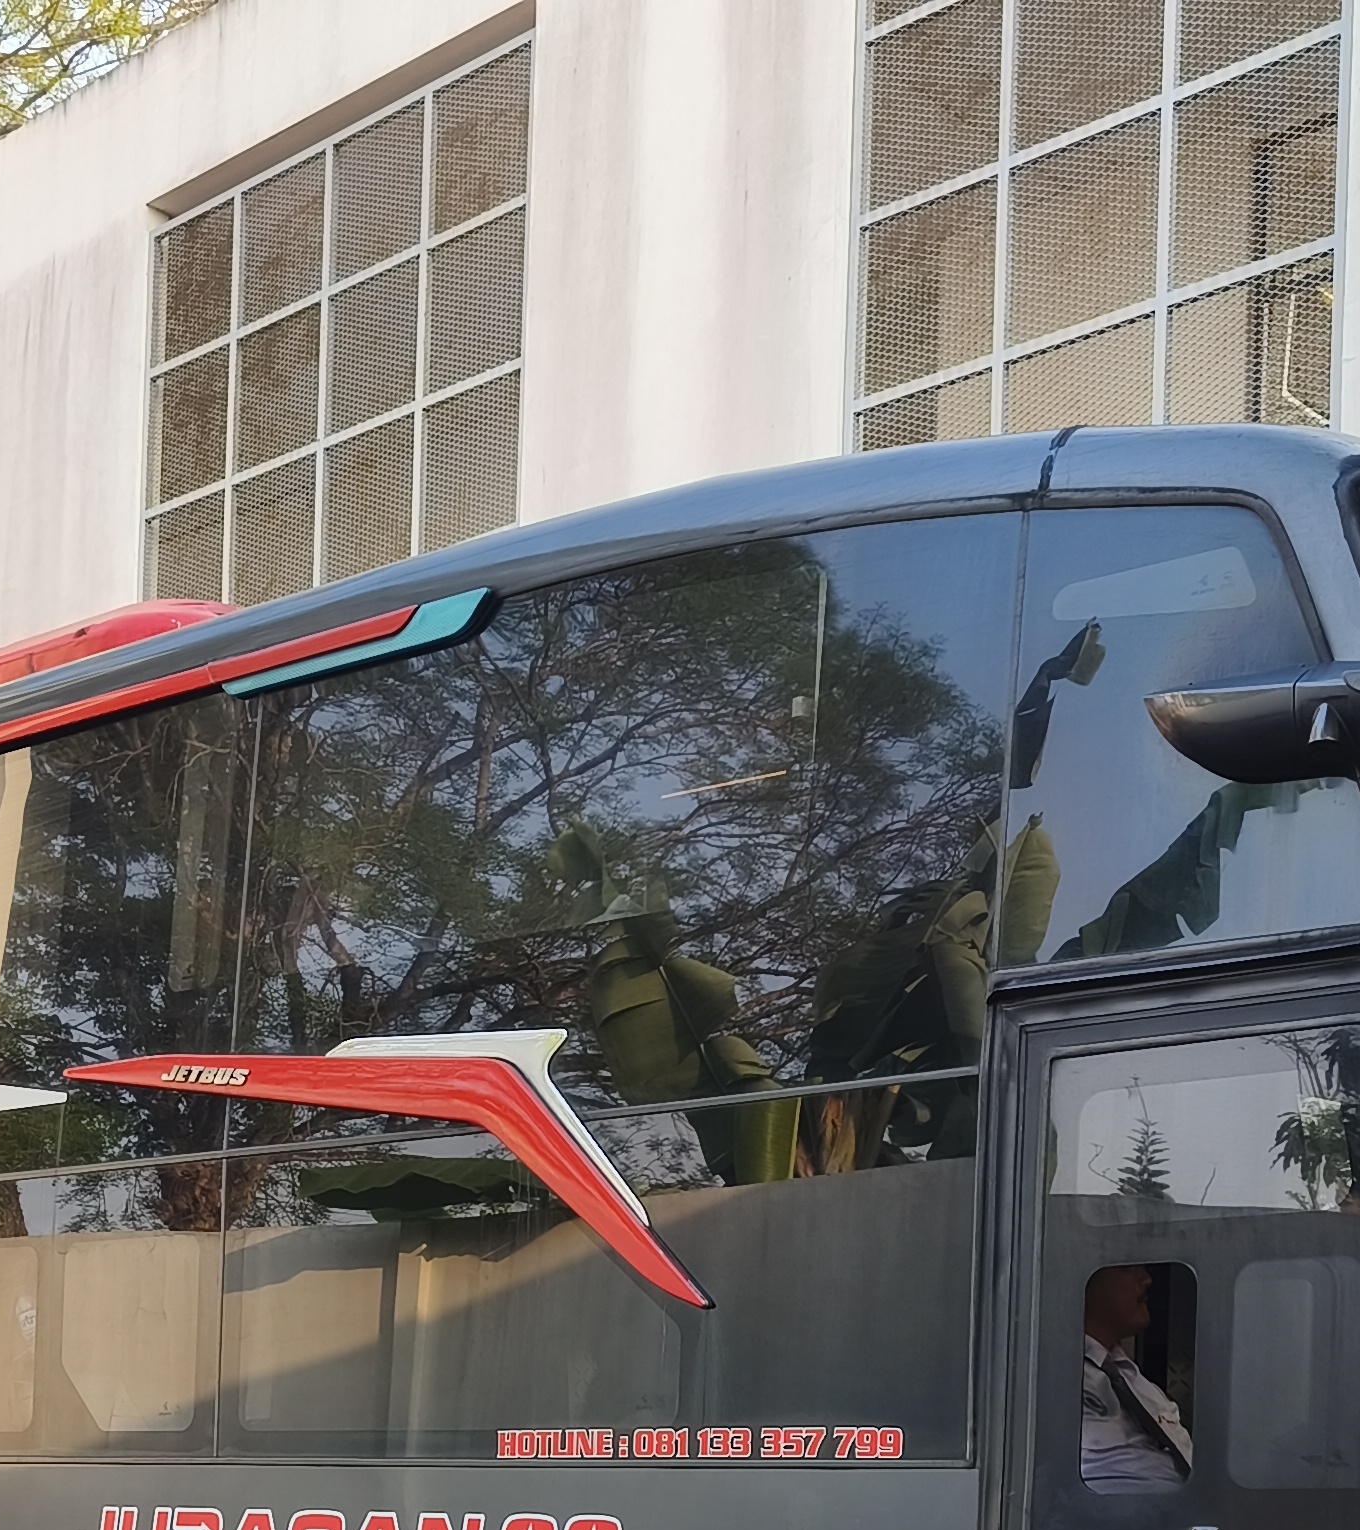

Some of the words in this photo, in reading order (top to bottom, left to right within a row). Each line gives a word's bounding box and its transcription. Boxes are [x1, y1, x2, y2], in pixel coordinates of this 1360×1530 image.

[161, 1065, 249, 1086] JETBUS
[497, 1428, 613, 1458] HOTLINE
[633, 1428, 689, 1458] 081
[697, 1427, 751, 1458] 133
[761, 1427, 826, 1458] 357
[833, 1427, 903, 1458] 799
